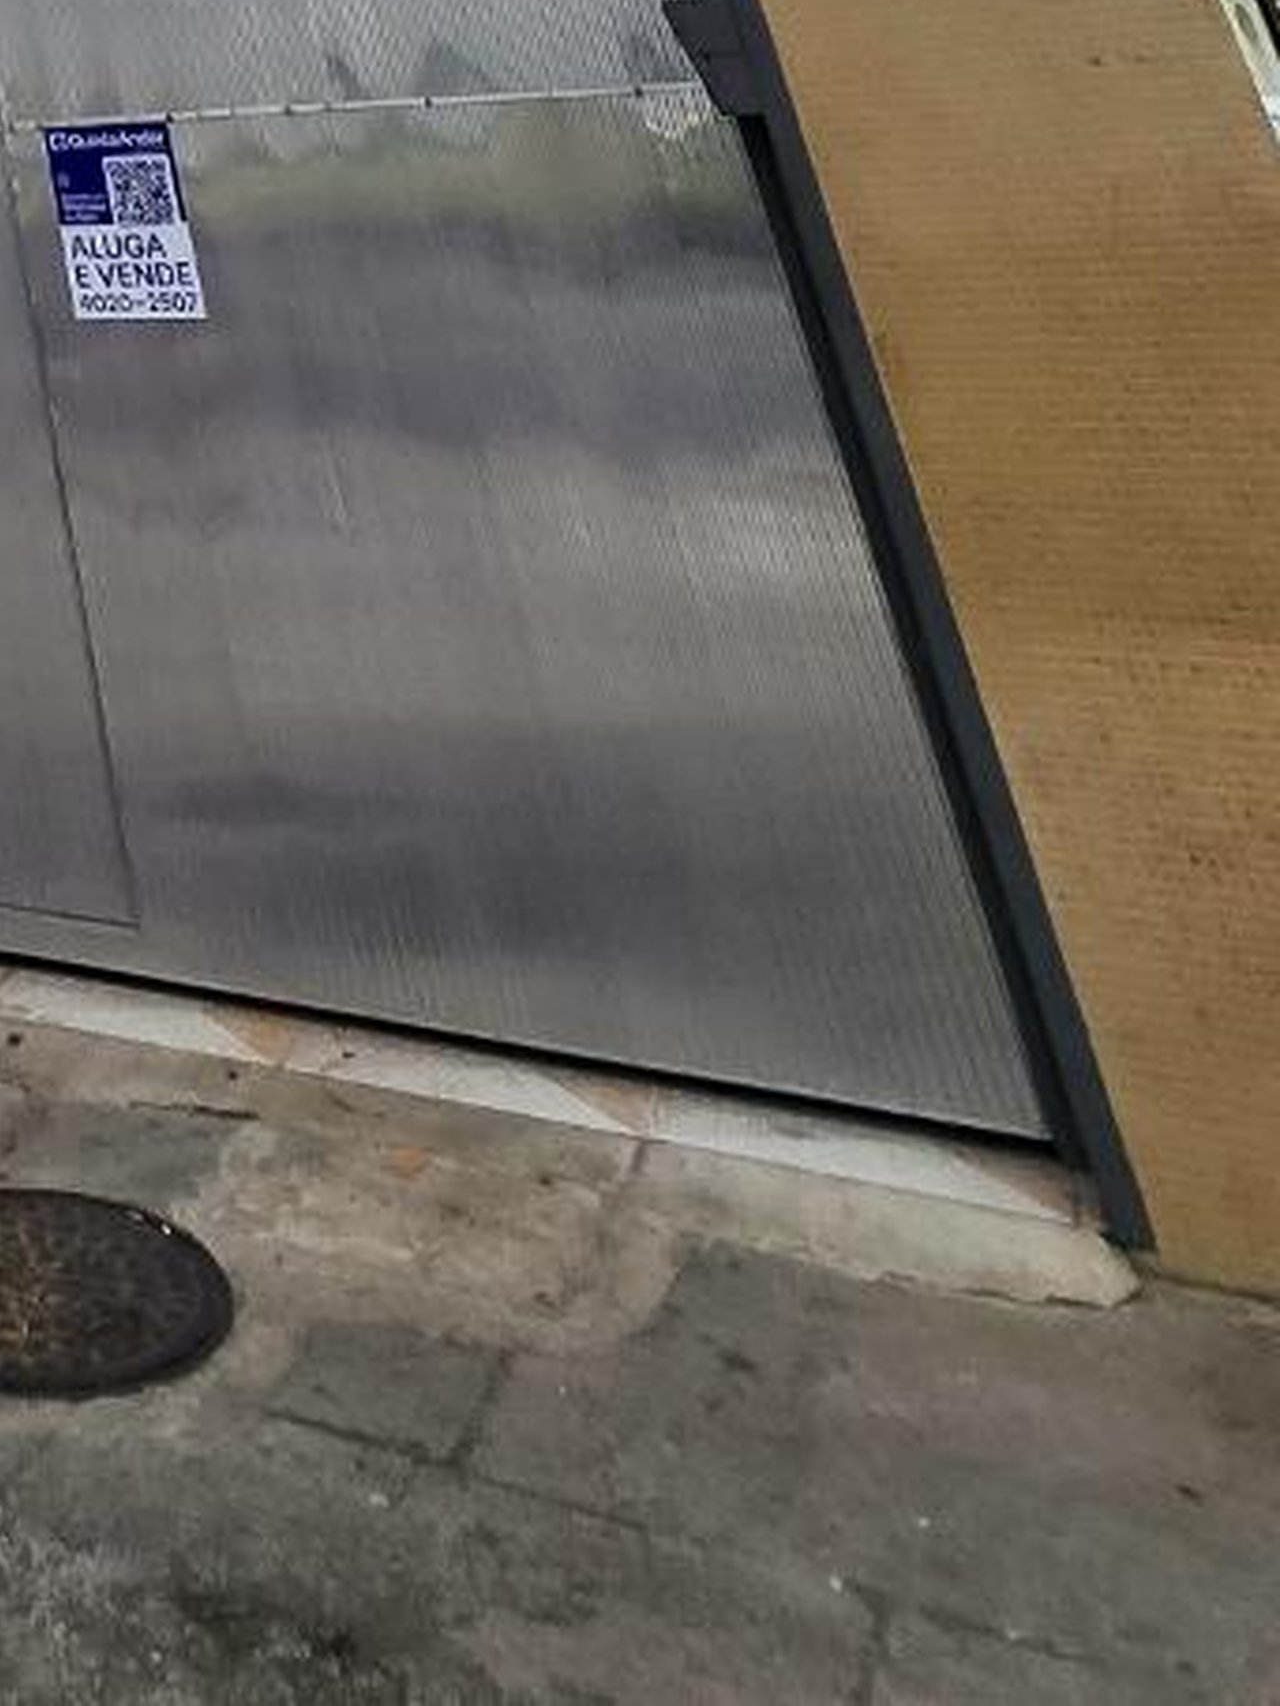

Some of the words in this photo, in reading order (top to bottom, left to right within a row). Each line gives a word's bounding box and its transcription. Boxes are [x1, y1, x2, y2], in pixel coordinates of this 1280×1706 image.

[72, 233, 169, 260] ALUGA
[75, 264, 90, 288] E
[94, 261, 194, 288] VENDE
